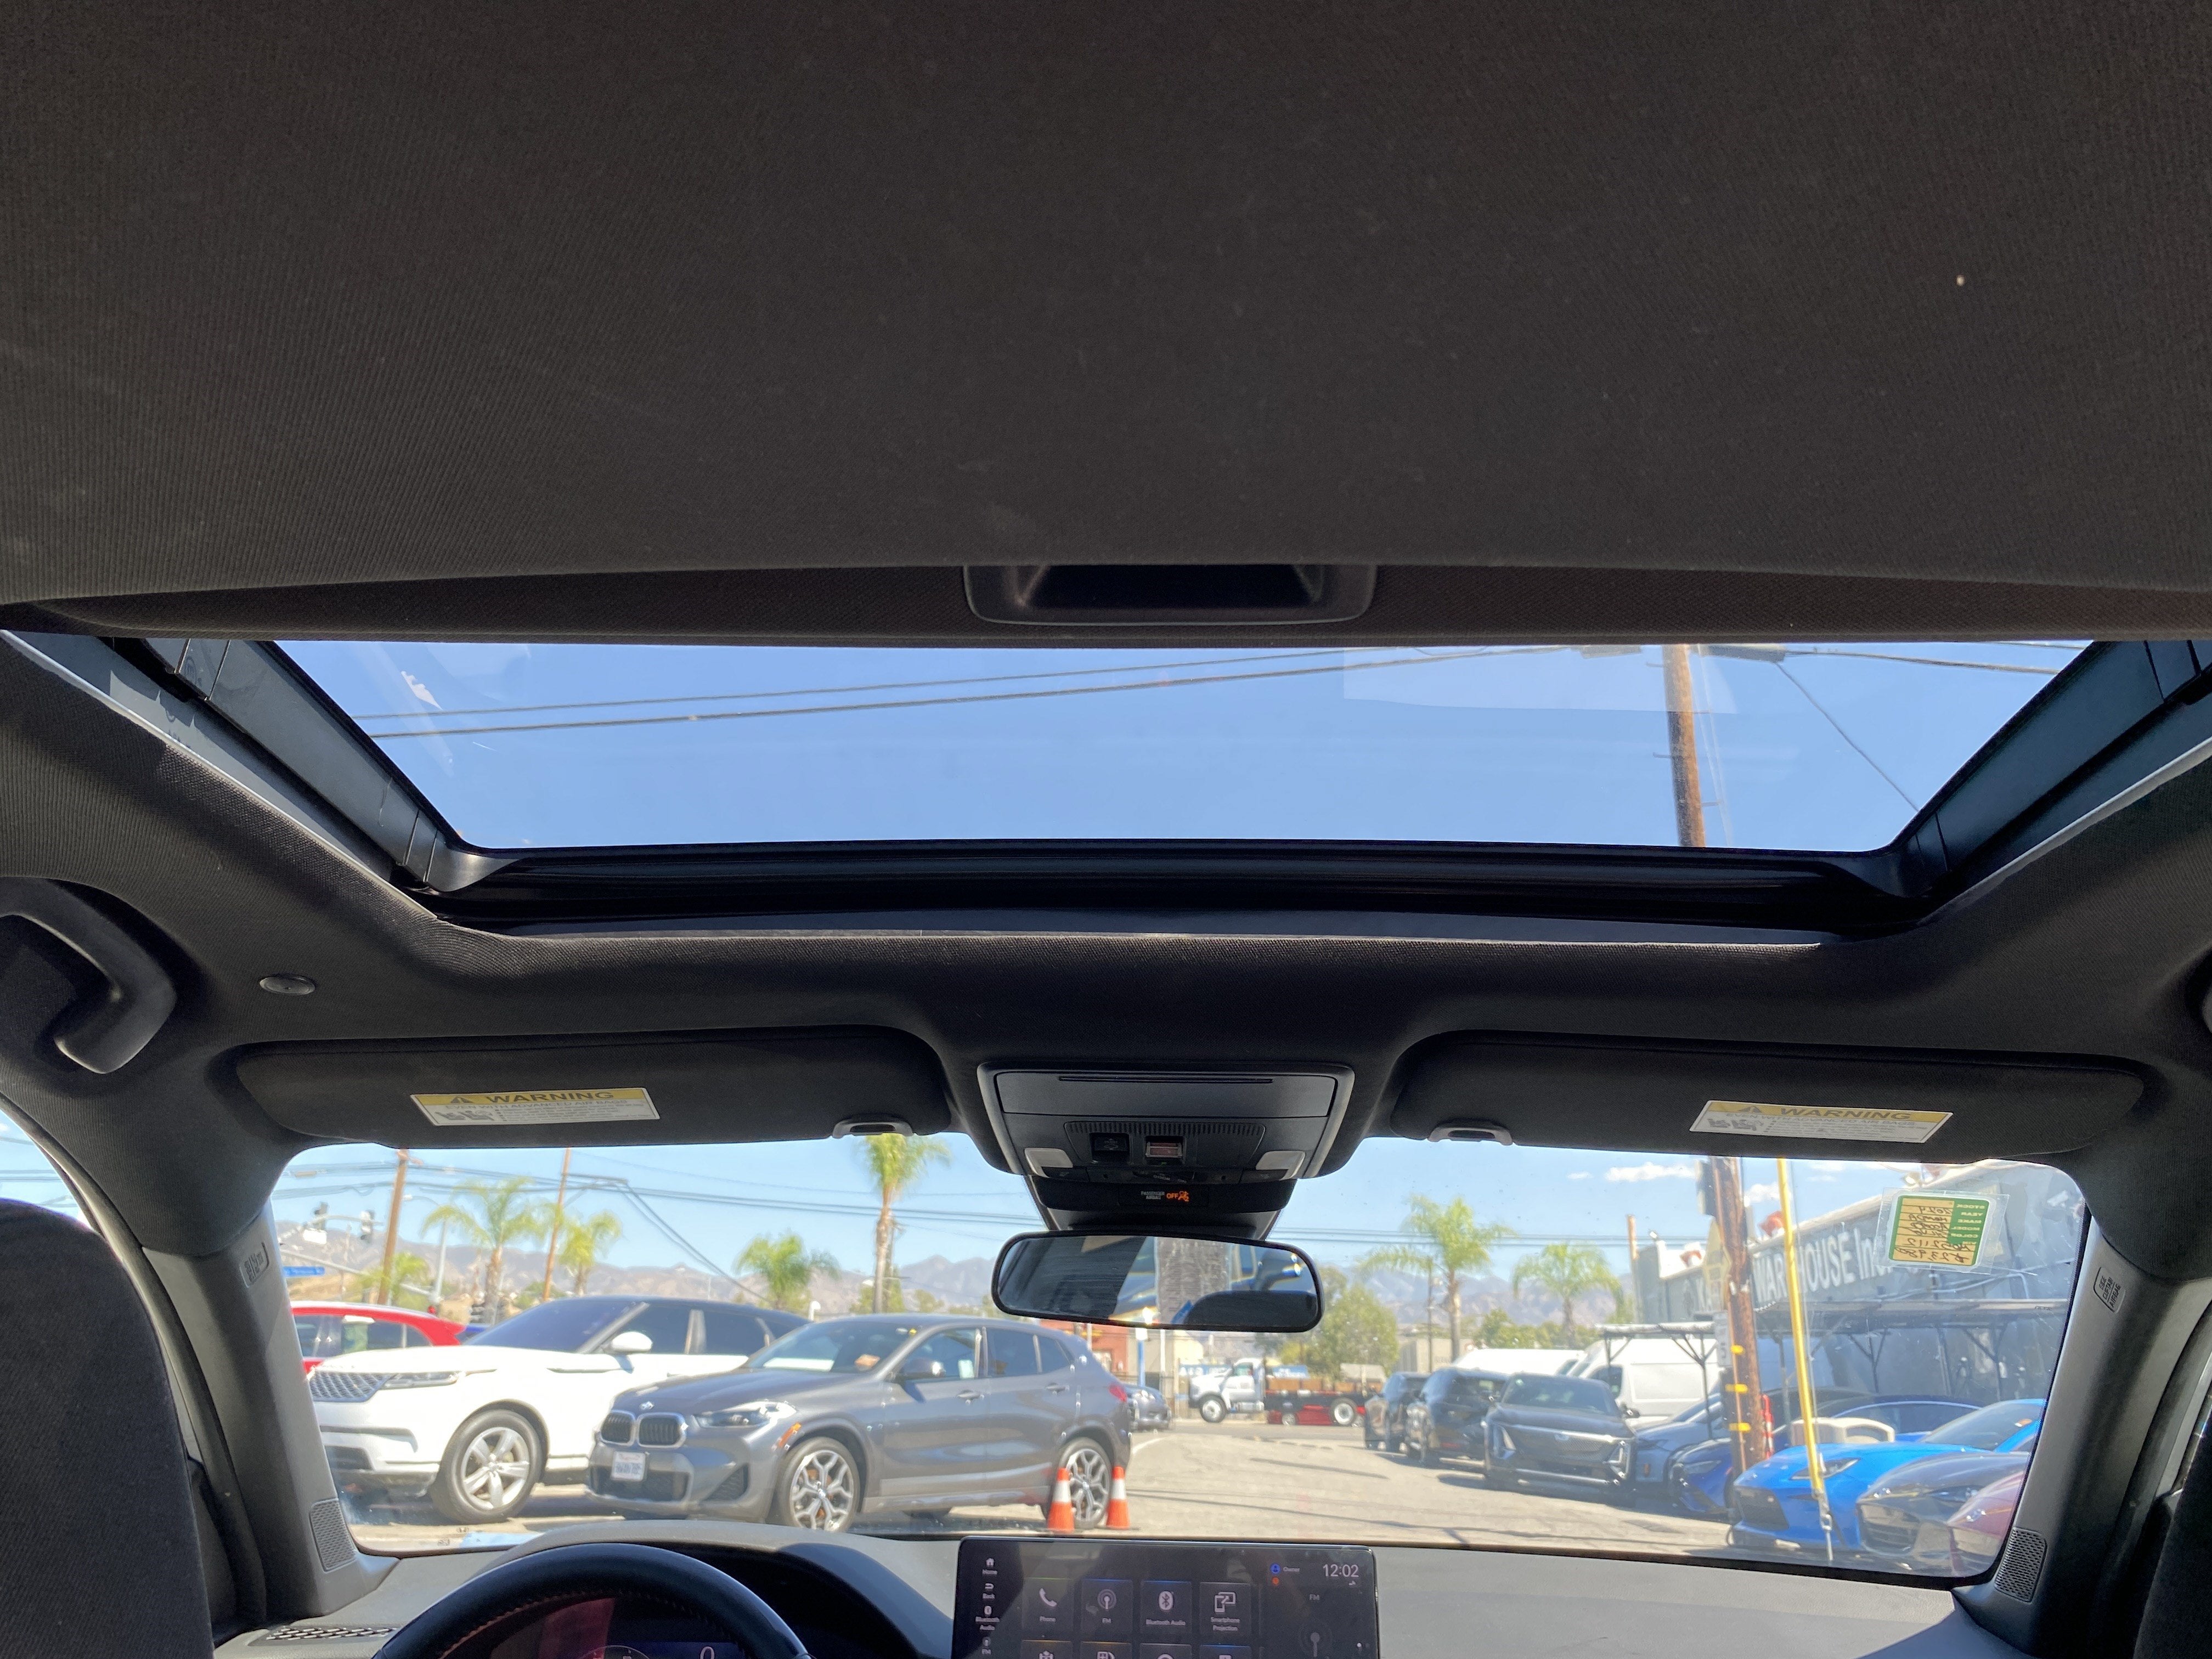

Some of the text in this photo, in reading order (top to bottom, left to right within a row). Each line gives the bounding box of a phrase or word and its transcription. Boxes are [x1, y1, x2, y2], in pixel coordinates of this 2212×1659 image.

[486, 1092, 614, 1103] WARNING
[1781, 1108, 1910, 1119] WARNING
[1323, 1564, 1359, 1578] 12:02
